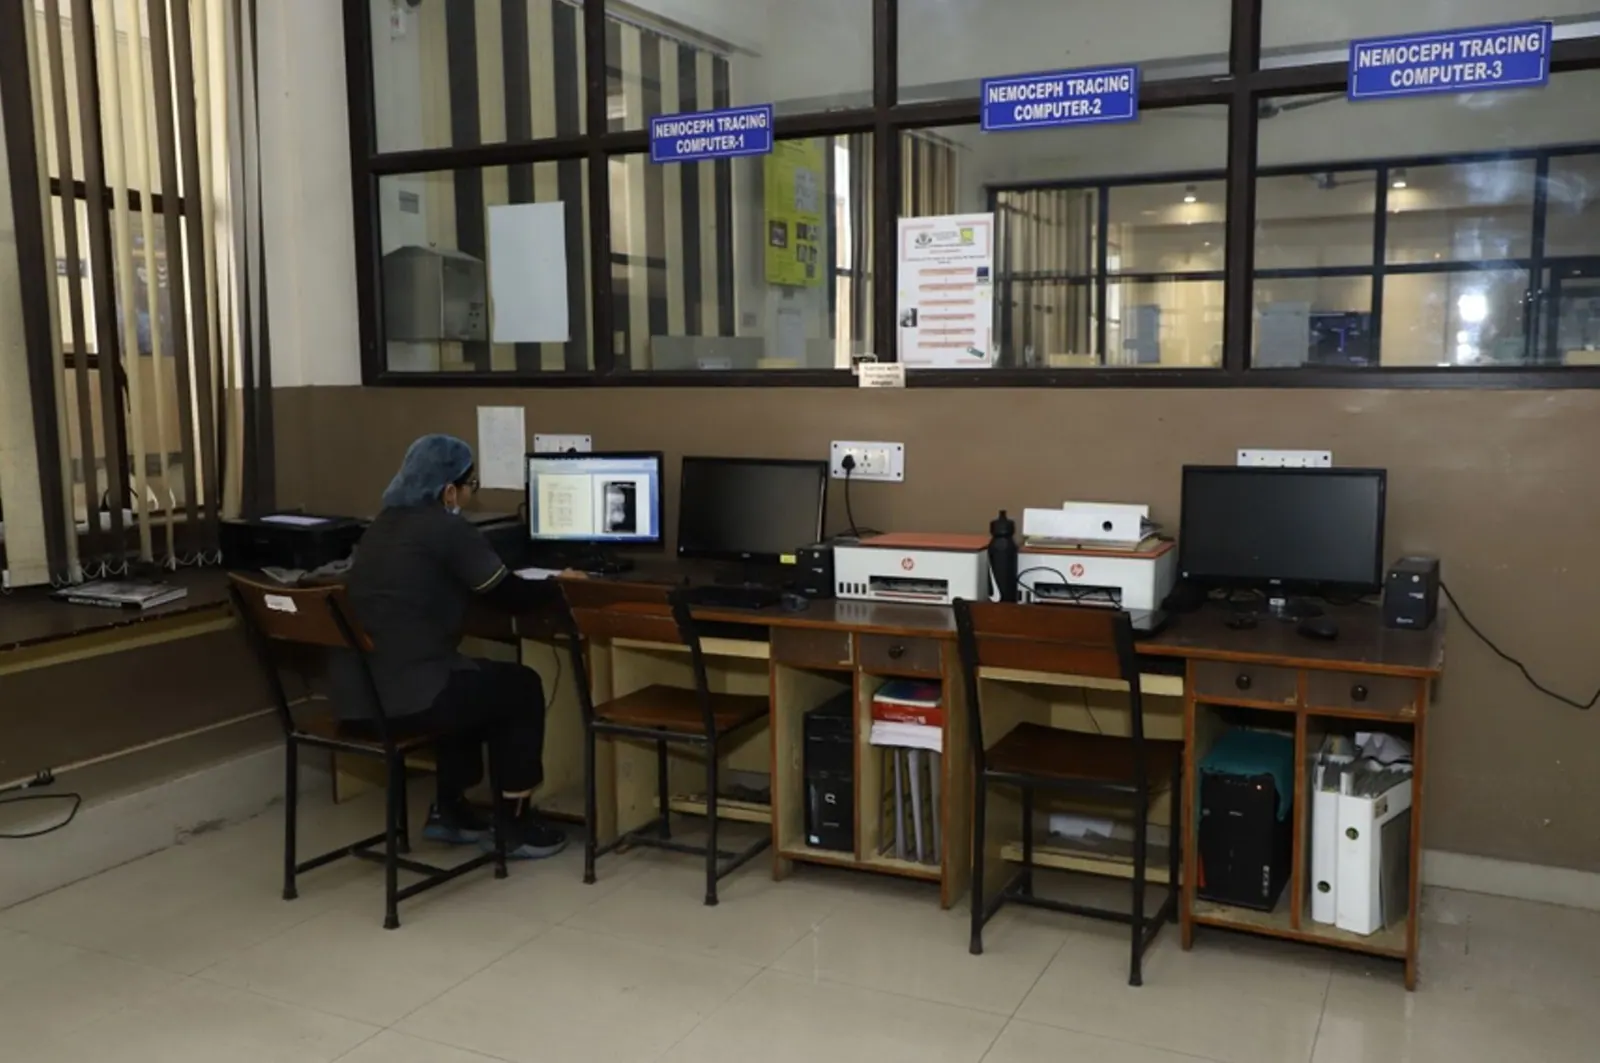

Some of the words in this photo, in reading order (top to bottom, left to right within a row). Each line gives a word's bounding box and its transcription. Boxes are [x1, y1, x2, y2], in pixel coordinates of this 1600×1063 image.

[1358, 41, 1454, 68] NEMOCEPH
[1459, 32, 1540, 58] TRACING
[1390, 60, 1503, 87] COMPUTER-3
[989, 80, 1064, 103] NEMOCEPH
[1067, 75, 1130, 96] TRACING
[1014, 98, 1102, 121] COMPUTER-2
[655, 118, 715, 138] NEMOCEPH
[716, 113, 767, 132] TRACING
[676, 134, 744, 153] COMPUTER-1
